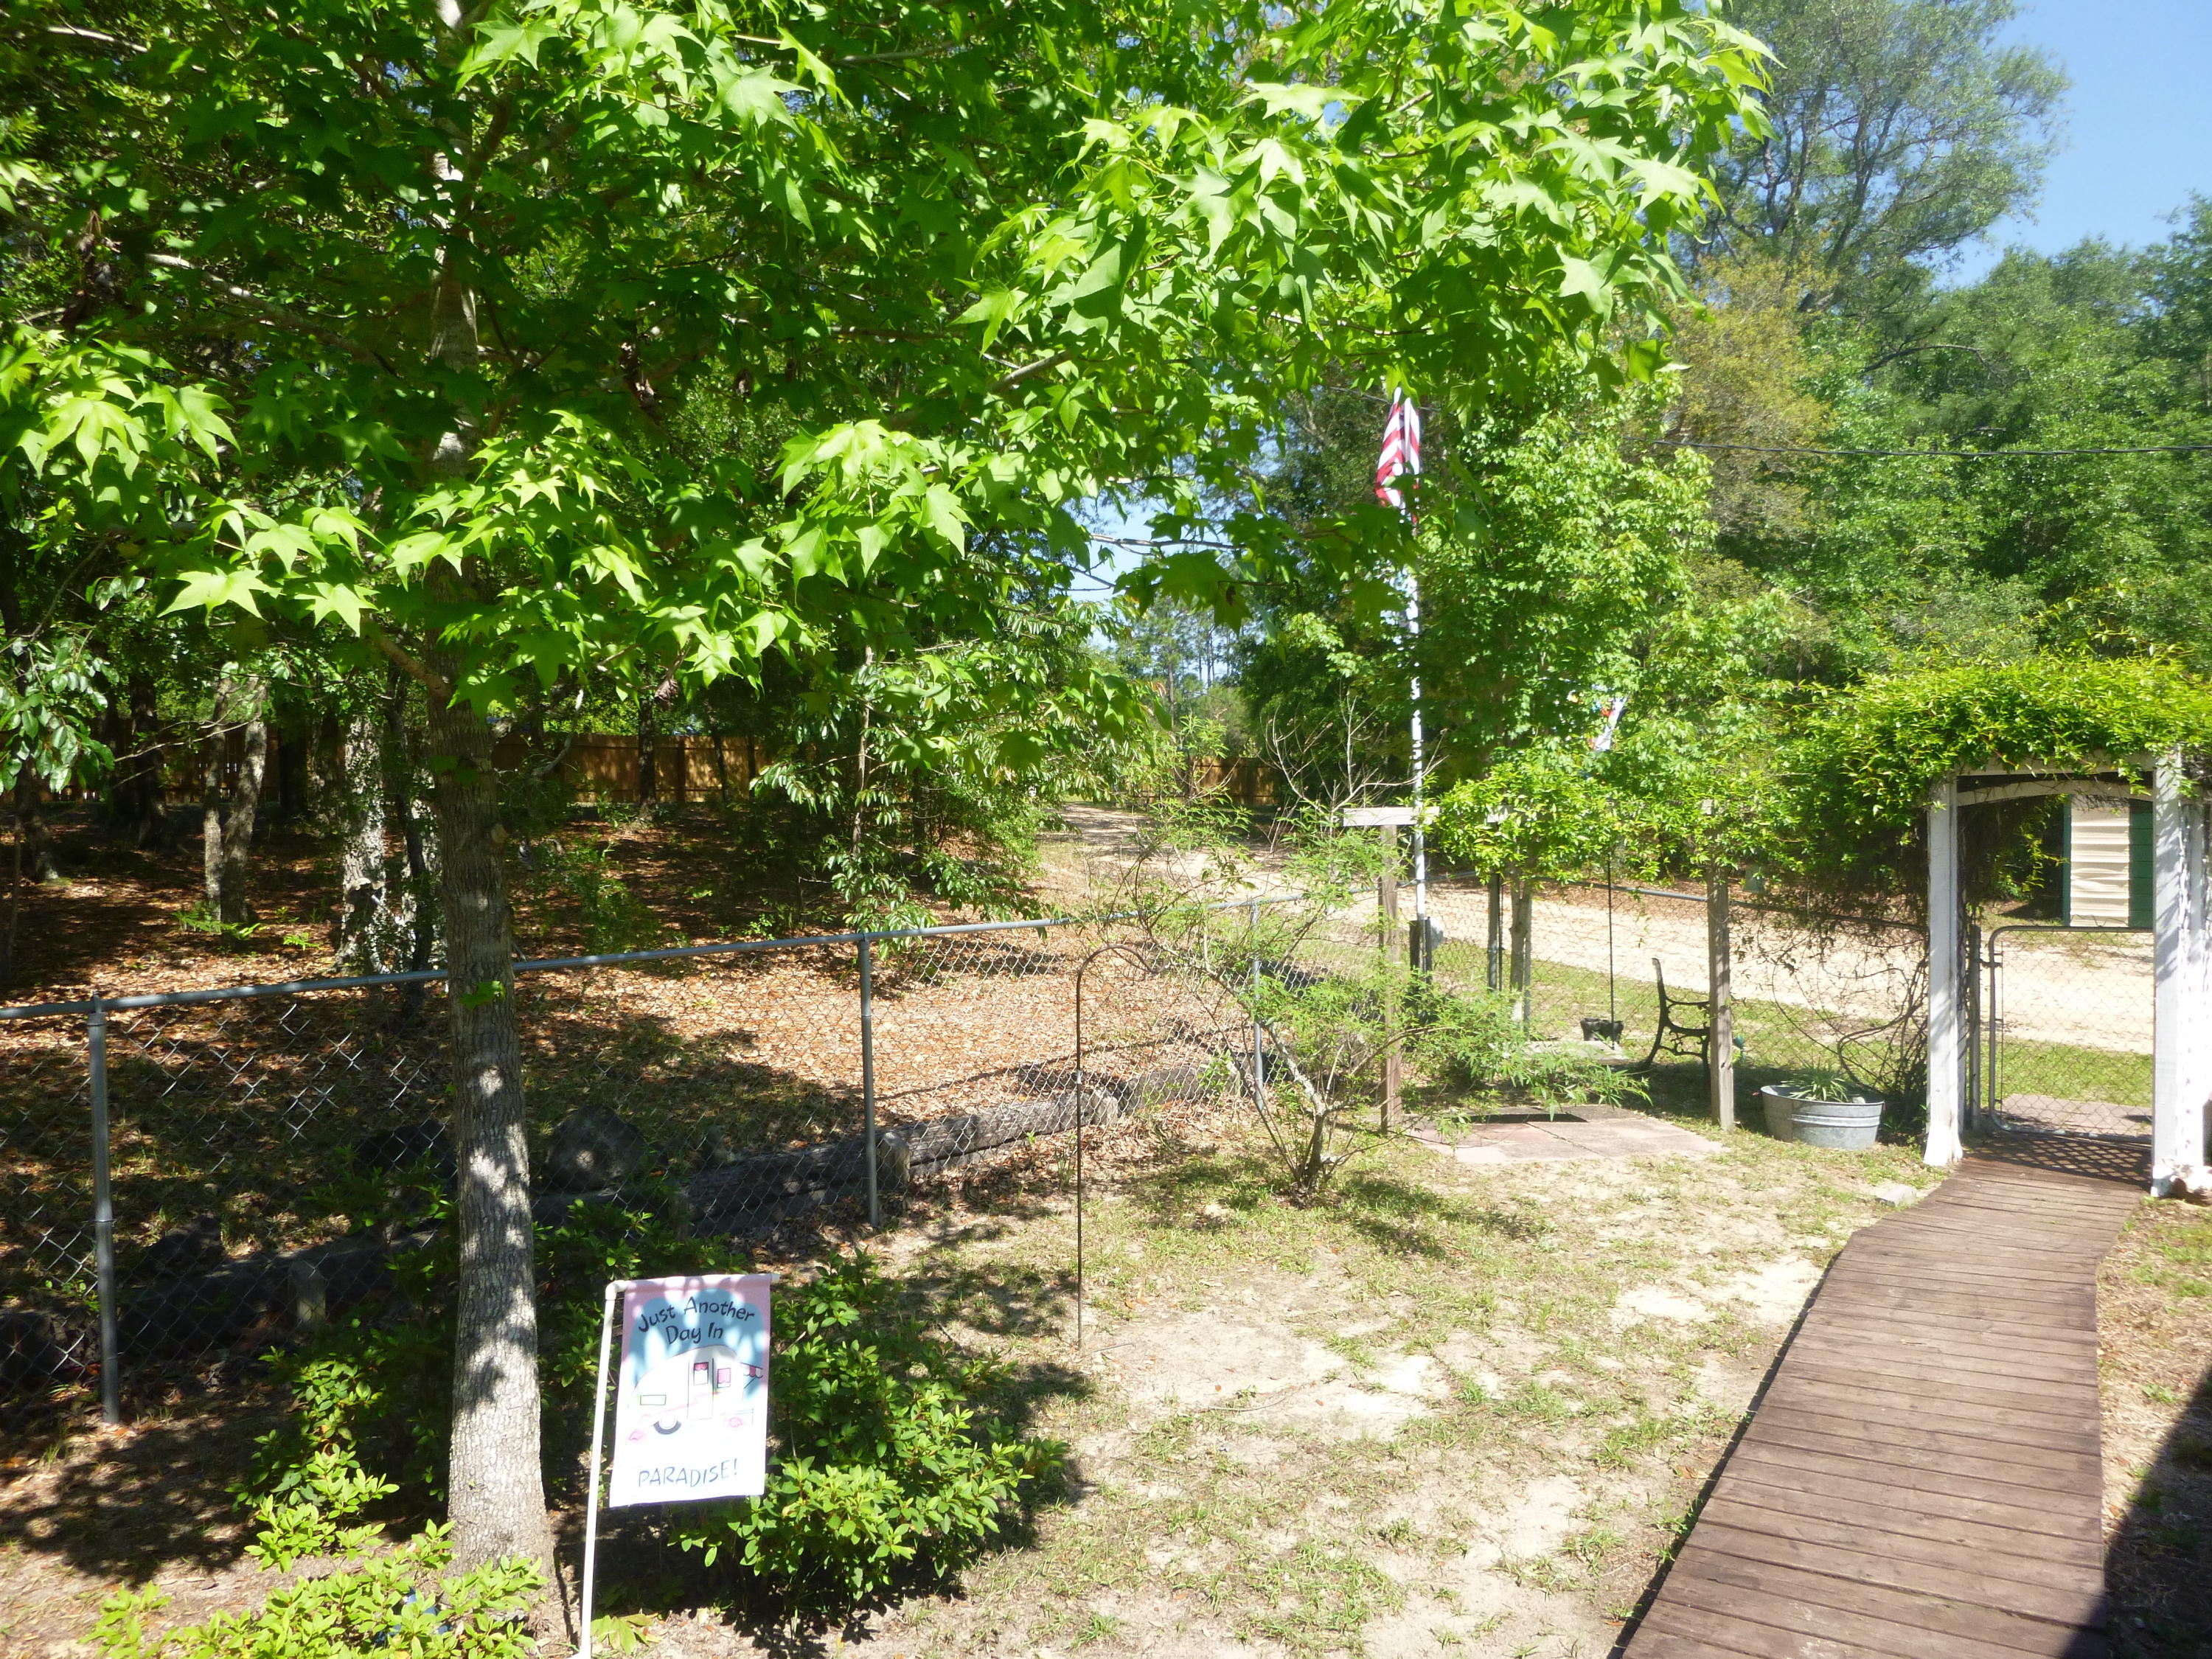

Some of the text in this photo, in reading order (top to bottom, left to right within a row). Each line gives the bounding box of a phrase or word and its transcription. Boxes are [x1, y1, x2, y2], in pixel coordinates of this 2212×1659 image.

[638, 1296, 756, 1332] Just Another
[666, 1322, 723, 1344] Day In
[639, 1458, 737, 1487] PARADISE!
